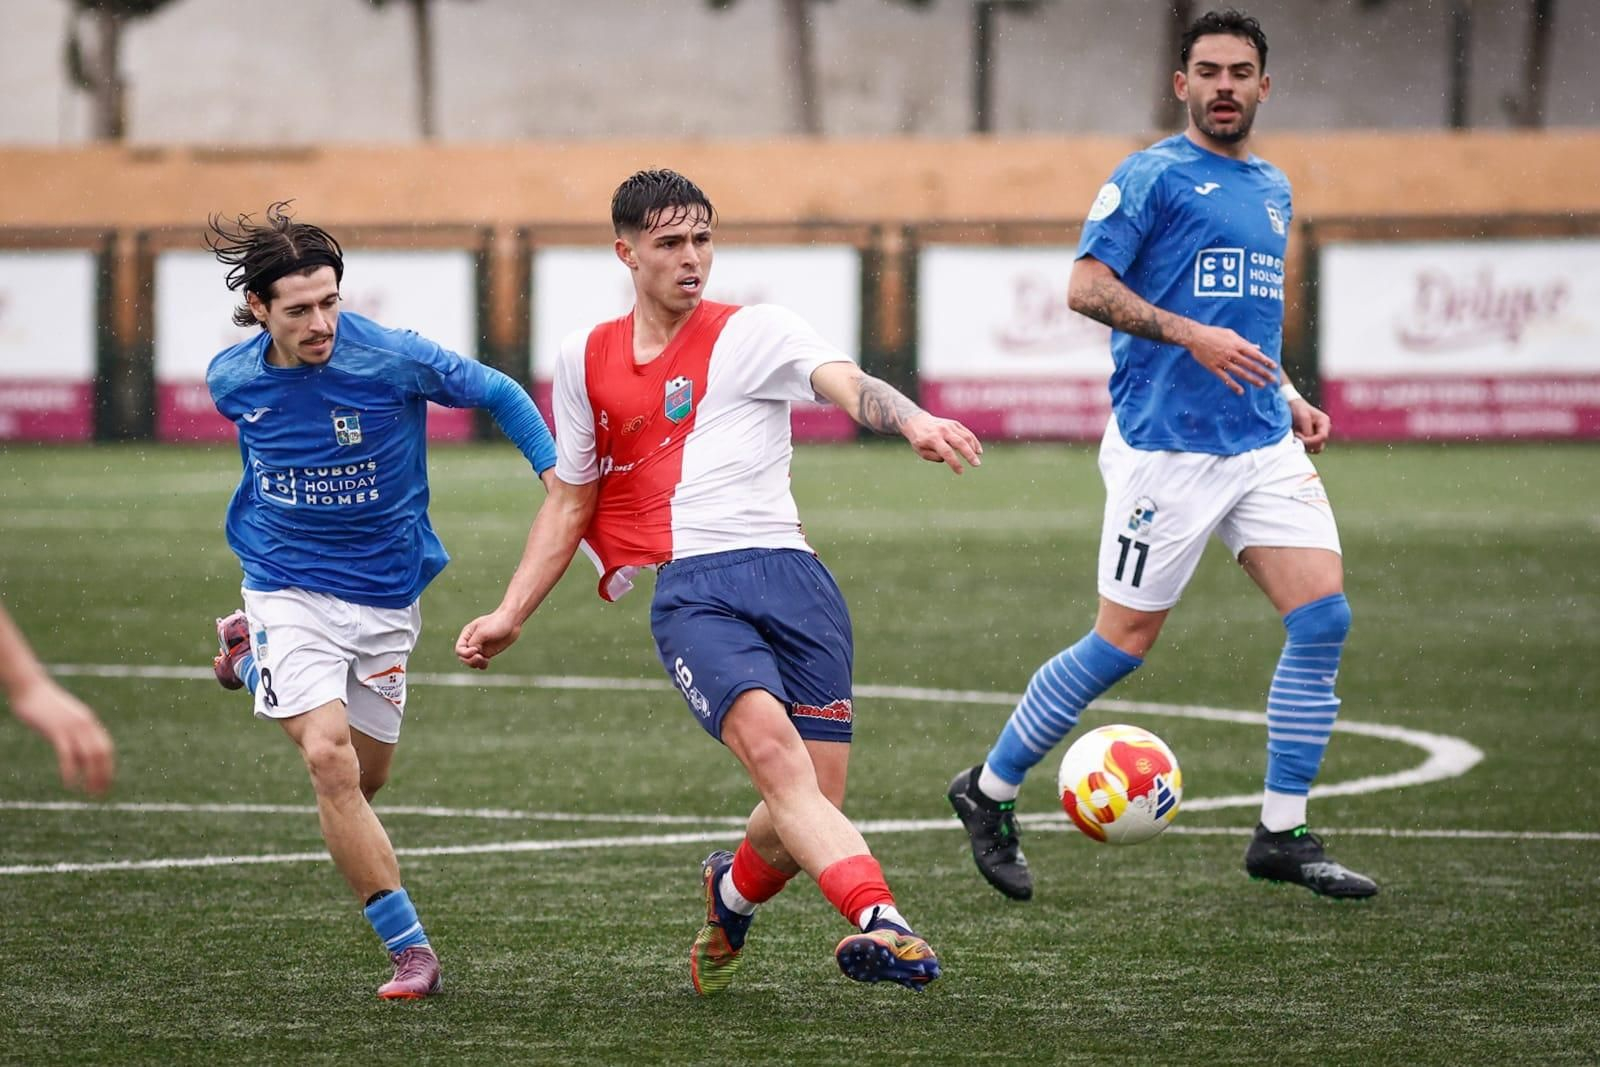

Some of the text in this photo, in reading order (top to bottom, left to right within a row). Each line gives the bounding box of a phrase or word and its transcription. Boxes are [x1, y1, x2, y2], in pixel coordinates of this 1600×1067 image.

[303, 460, 377, 477] CUBO'S
[305, 475, 377, 492] HOLIDAY
[305, 489, 379, 505] HOMES
[1114, 534, 1150, 588] 11
[261, 667, 279, 707] 8
